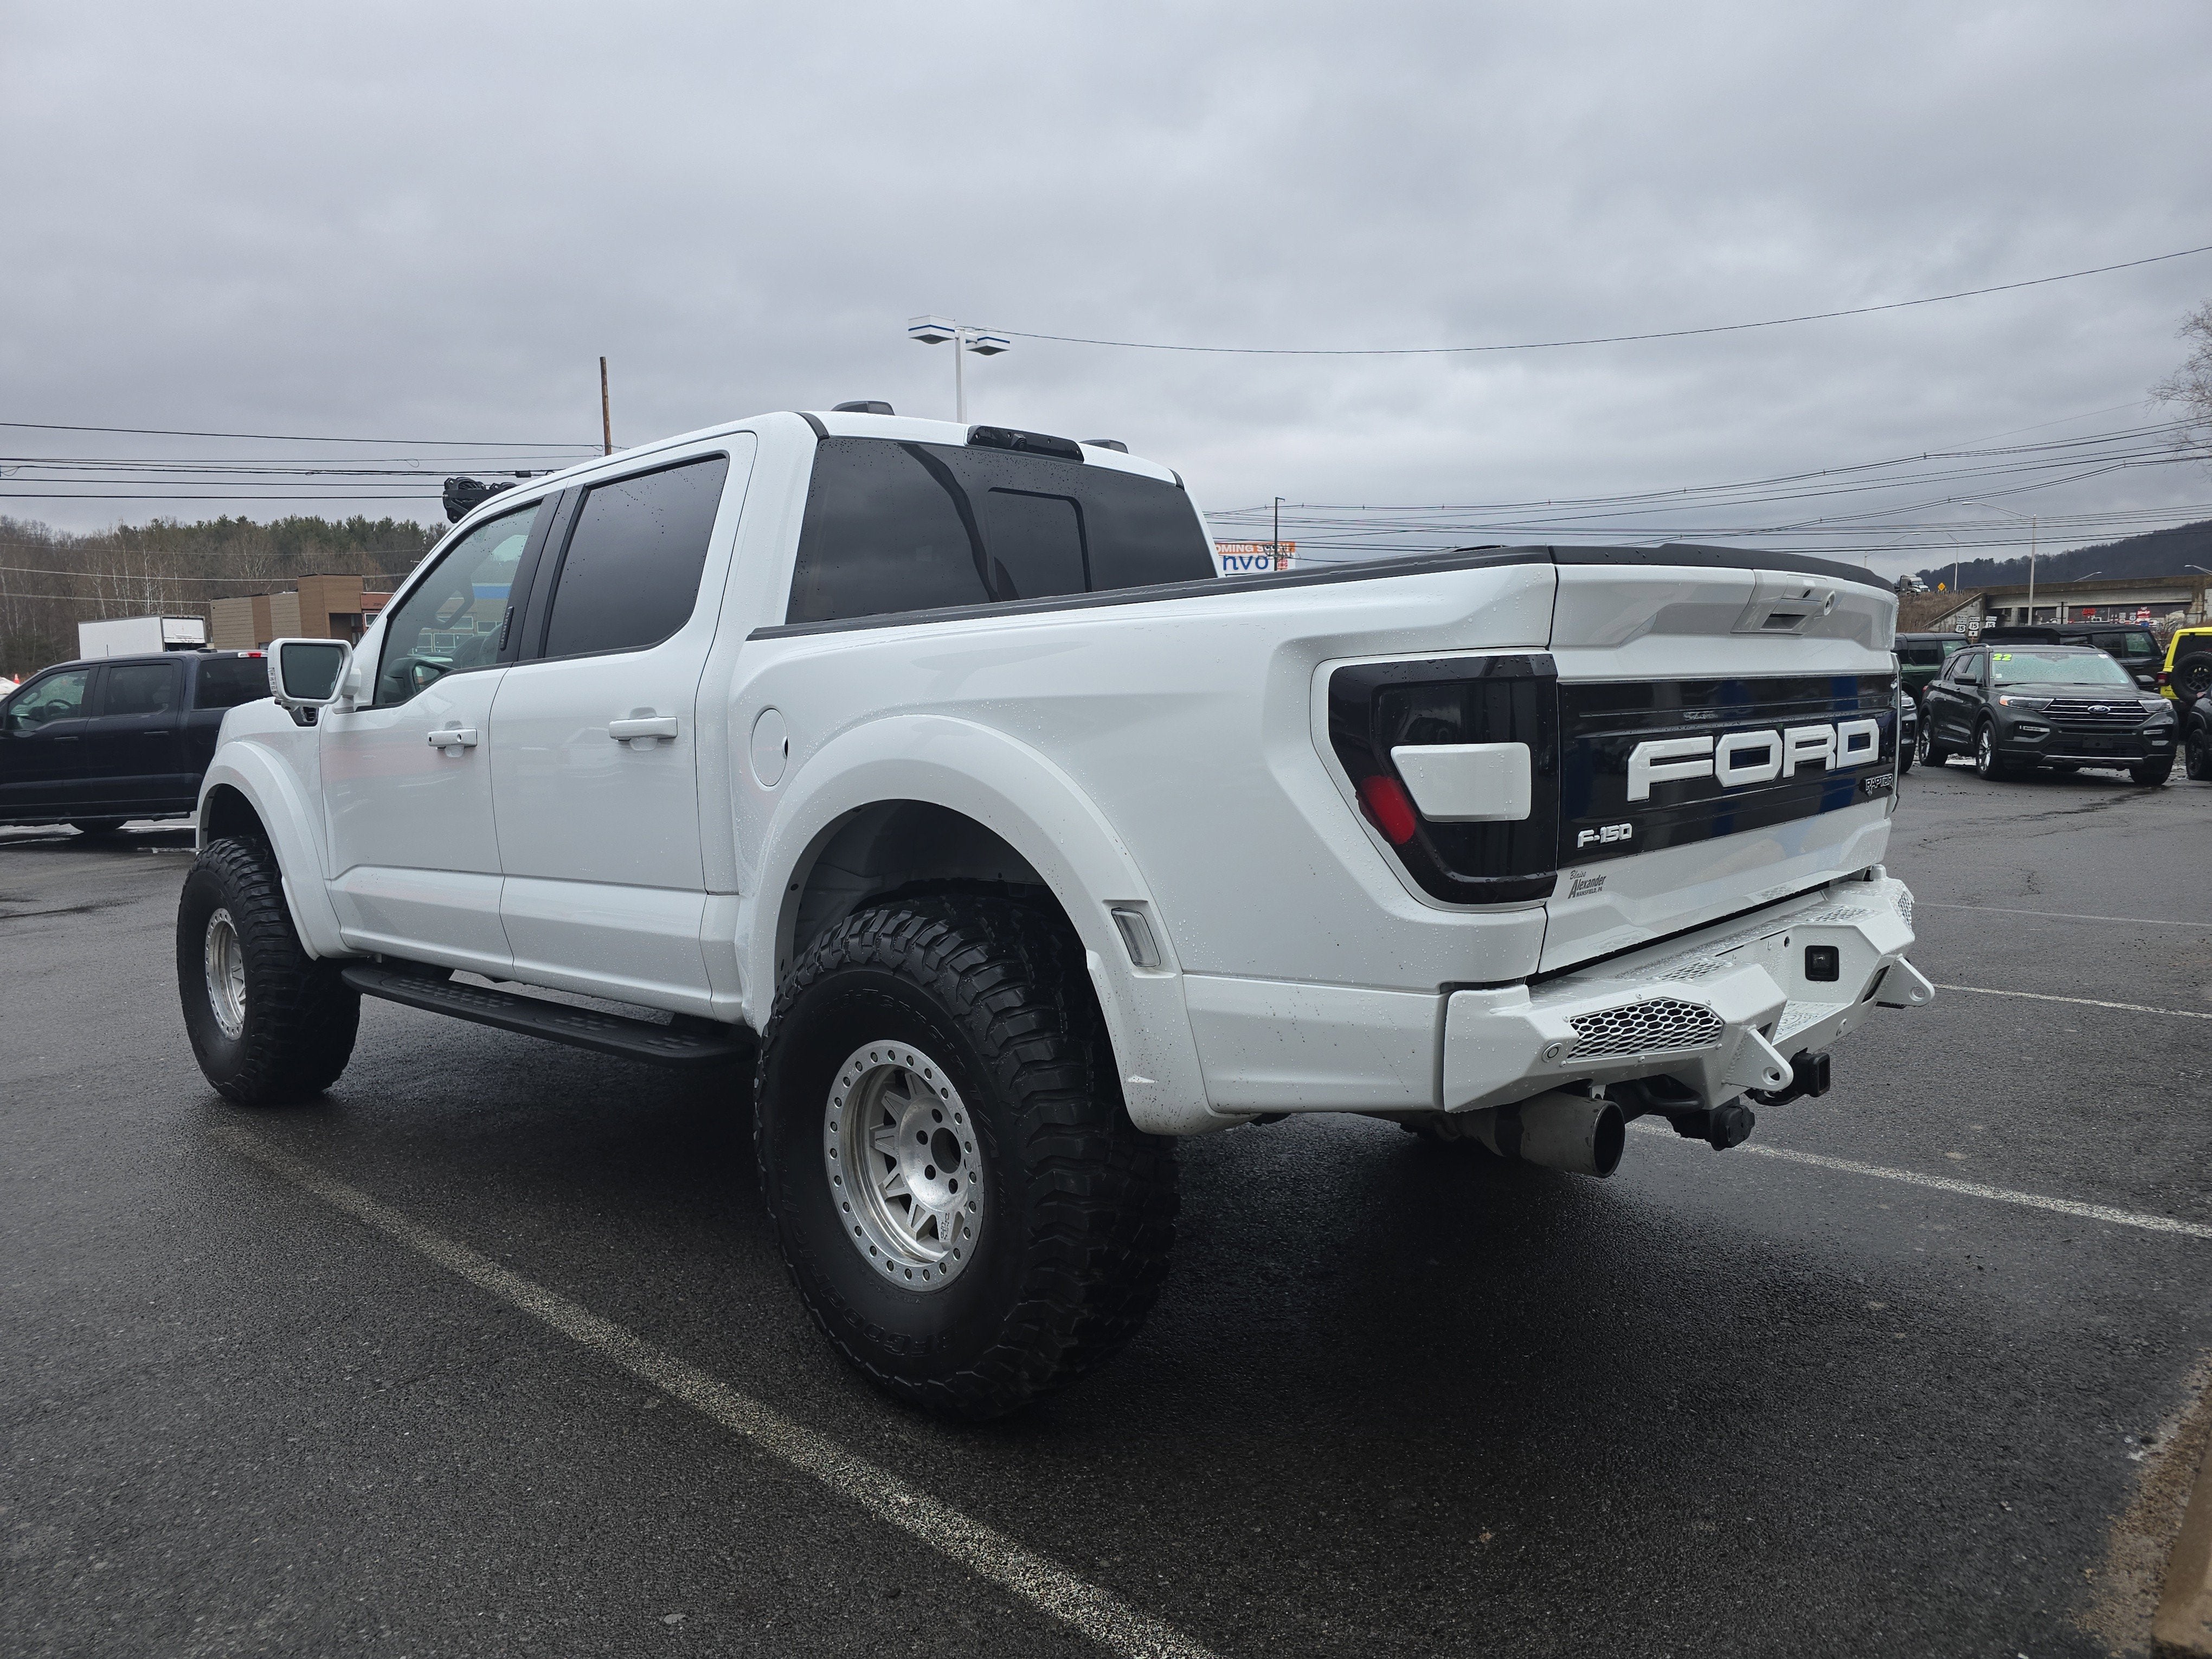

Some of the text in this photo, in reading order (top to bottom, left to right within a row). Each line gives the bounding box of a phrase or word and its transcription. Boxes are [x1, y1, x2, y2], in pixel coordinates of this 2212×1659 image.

[1992, 653, 2012, 661] 22
[1627, 718, 1880, 802] FORD
[1865, 774, 1894, 795] RAPTOR
[1577, 823, 1632, 848] F-150
[1567, 874, 1607, 899] Alexander
